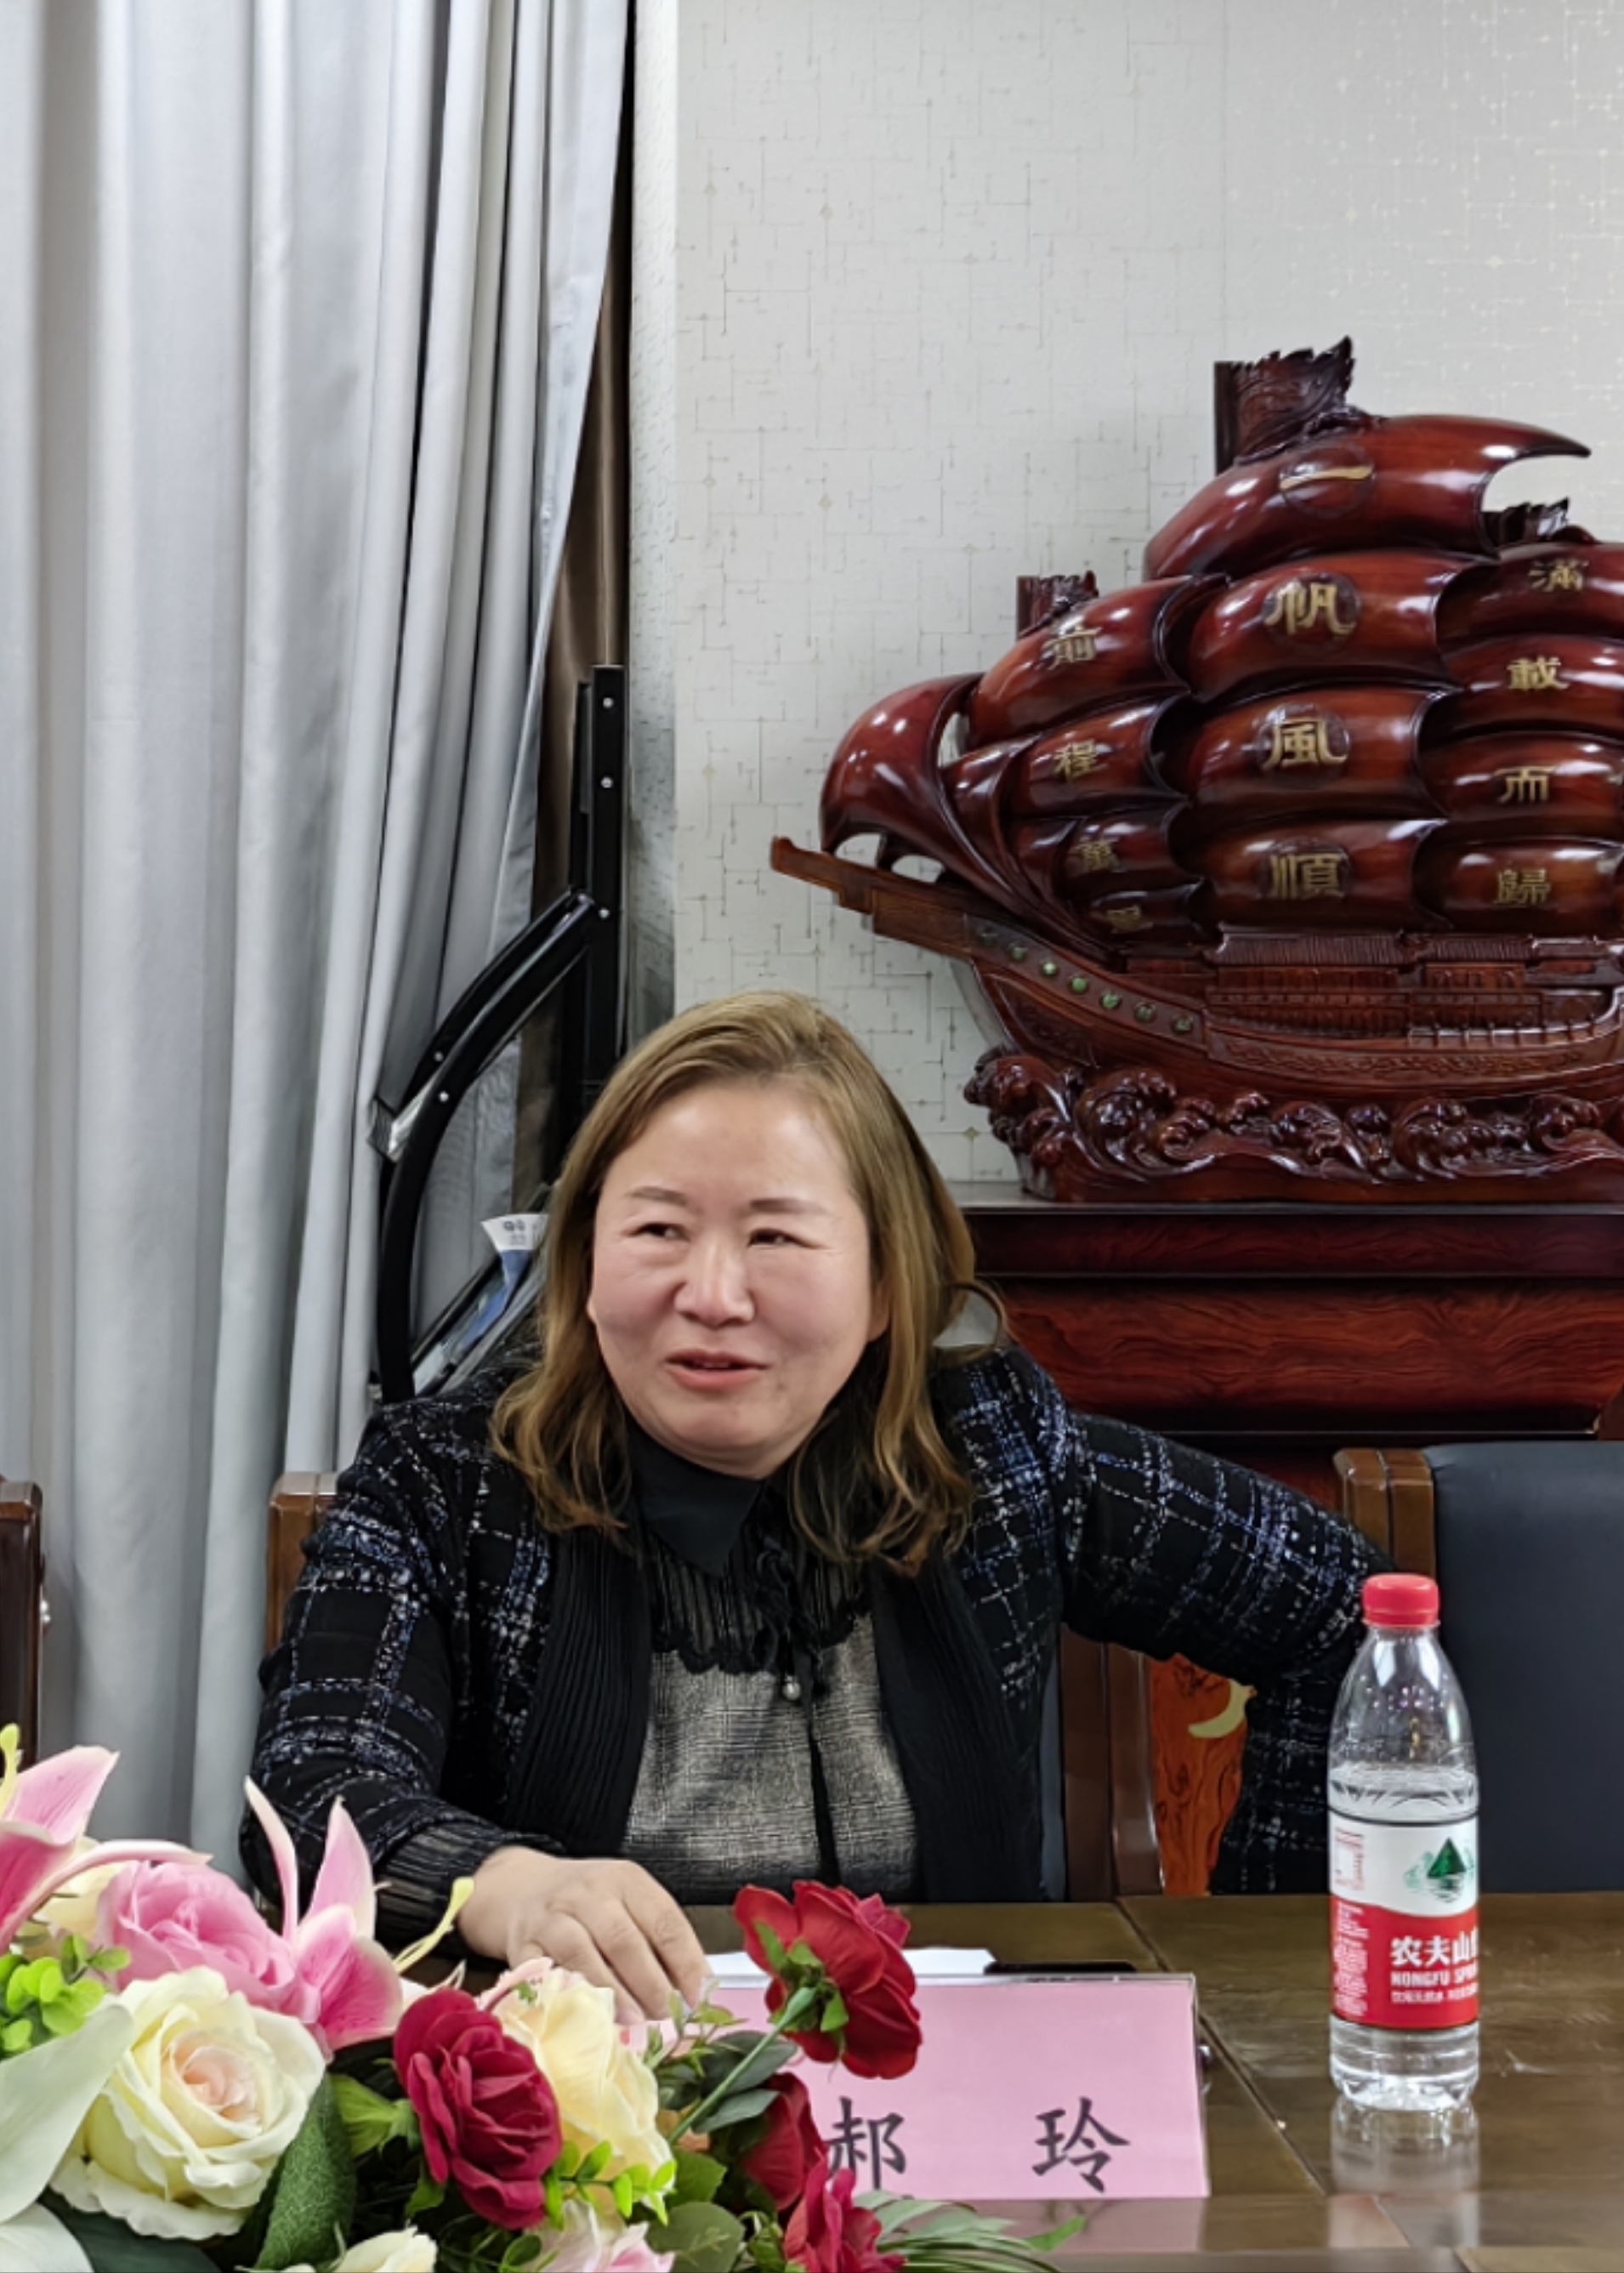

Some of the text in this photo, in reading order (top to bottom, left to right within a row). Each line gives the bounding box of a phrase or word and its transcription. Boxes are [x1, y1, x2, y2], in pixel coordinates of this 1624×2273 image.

[1263, 465, 1373, 903] 一帆風順
[1390, 1926, 1478, 1968] 农夫山
[826, 2095, 1131, 2193] 郝玲
